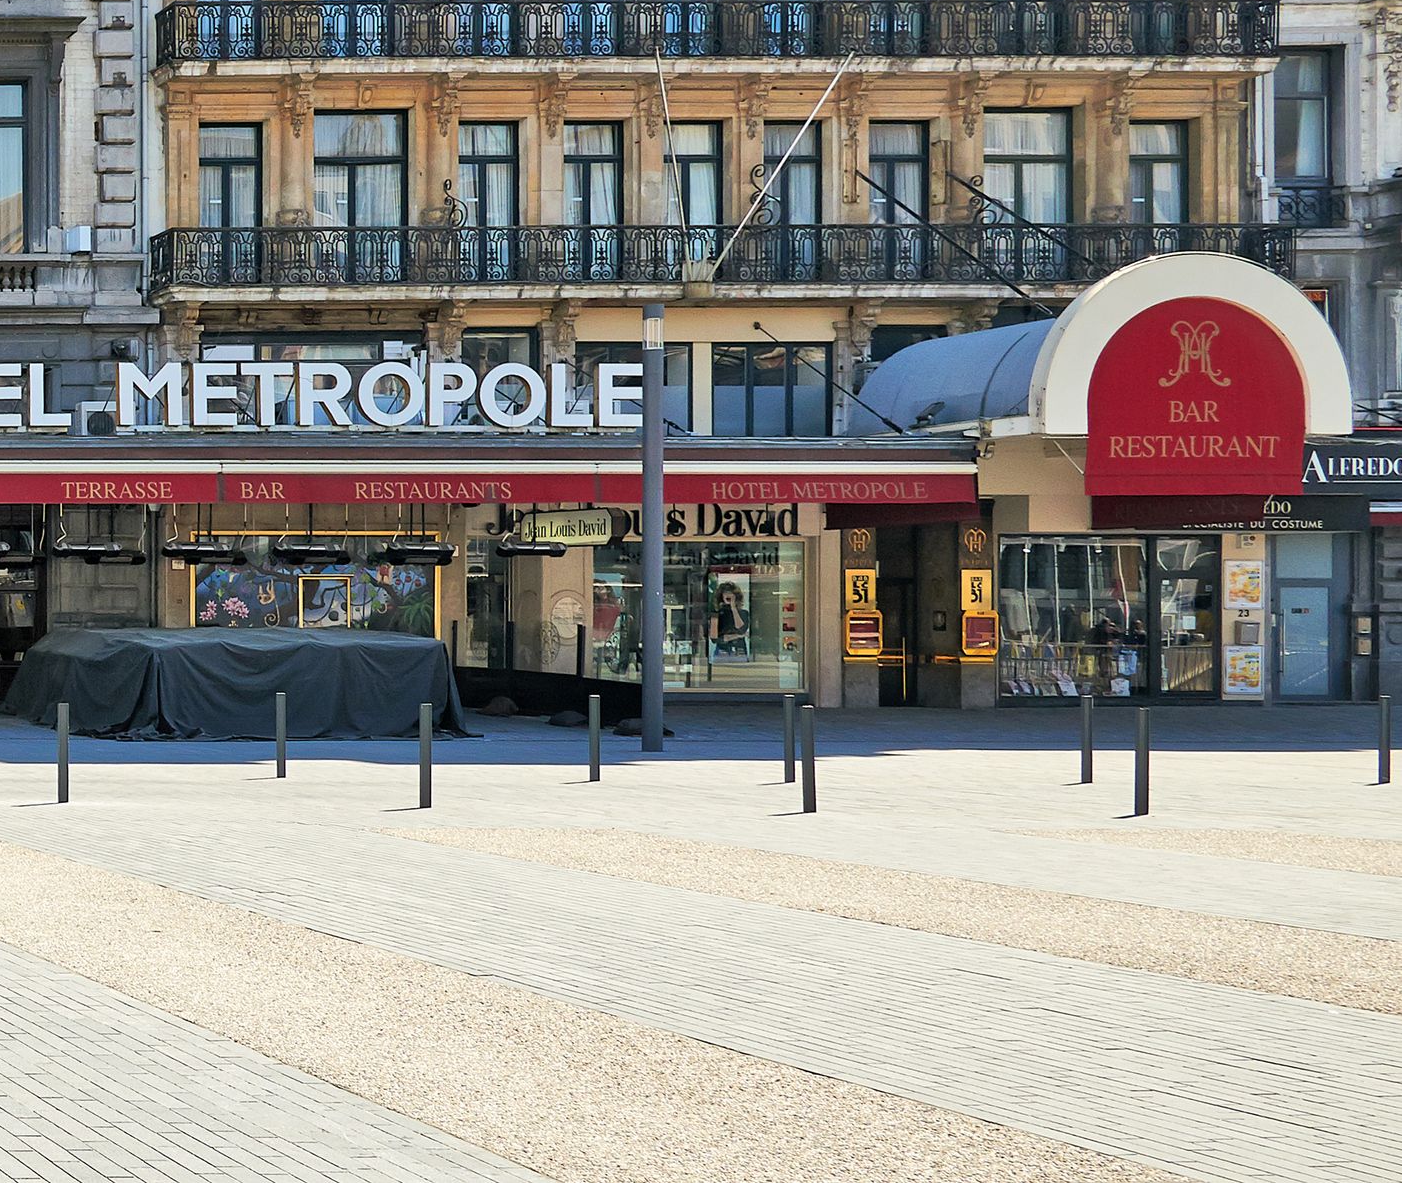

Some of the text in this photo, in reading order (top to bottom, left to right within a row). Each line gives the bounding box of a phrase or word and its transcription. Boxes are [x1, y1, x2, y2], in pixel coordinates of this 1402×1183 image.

[117, 360, 643, 428] METROPOLE
[1168, 400, 1219, 423] BAR
[1109, 435, 1281, 458] RESTAURANT
[61, 481, 173, 499] TERRASSE
[240, 481, 512, 499] BAR RESTAURANTS
[712, 482, 929, 499] HOTEL METROPOLE
[524, 521, 547, 539] Jean
[550, 519, 577, 538] Louis
[578, 517, 607, 537] David
[1272, 520, 1324, 529] COSTUME
[667, 546, 719, 565] Lous
[1237, 609, 1250, 618] 23
